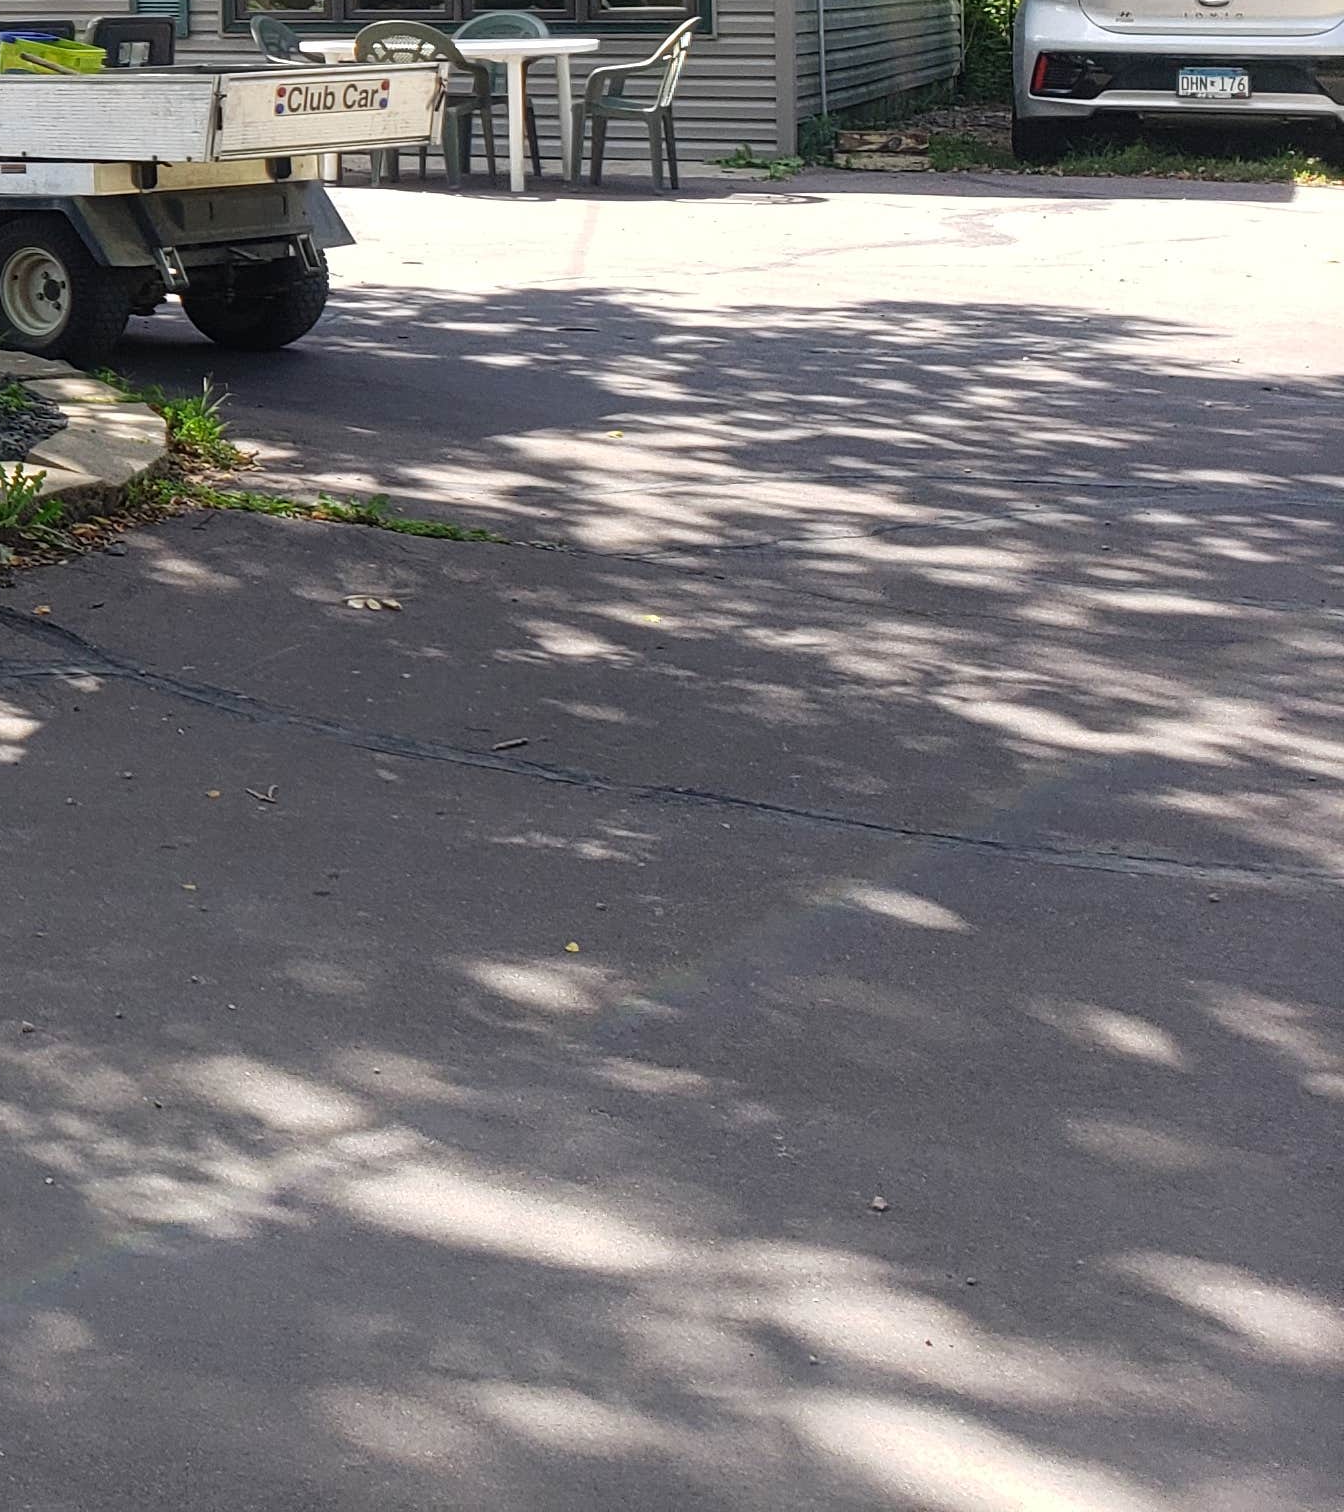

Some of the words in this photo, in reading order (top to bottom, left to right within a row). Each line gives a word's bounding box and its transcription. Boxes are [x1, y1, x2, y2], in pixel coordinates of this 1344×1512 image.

[1219, 76, 1245, 91] 176
[287, 86, 335, 113] Club
[343, 84, 378, 109] Car
